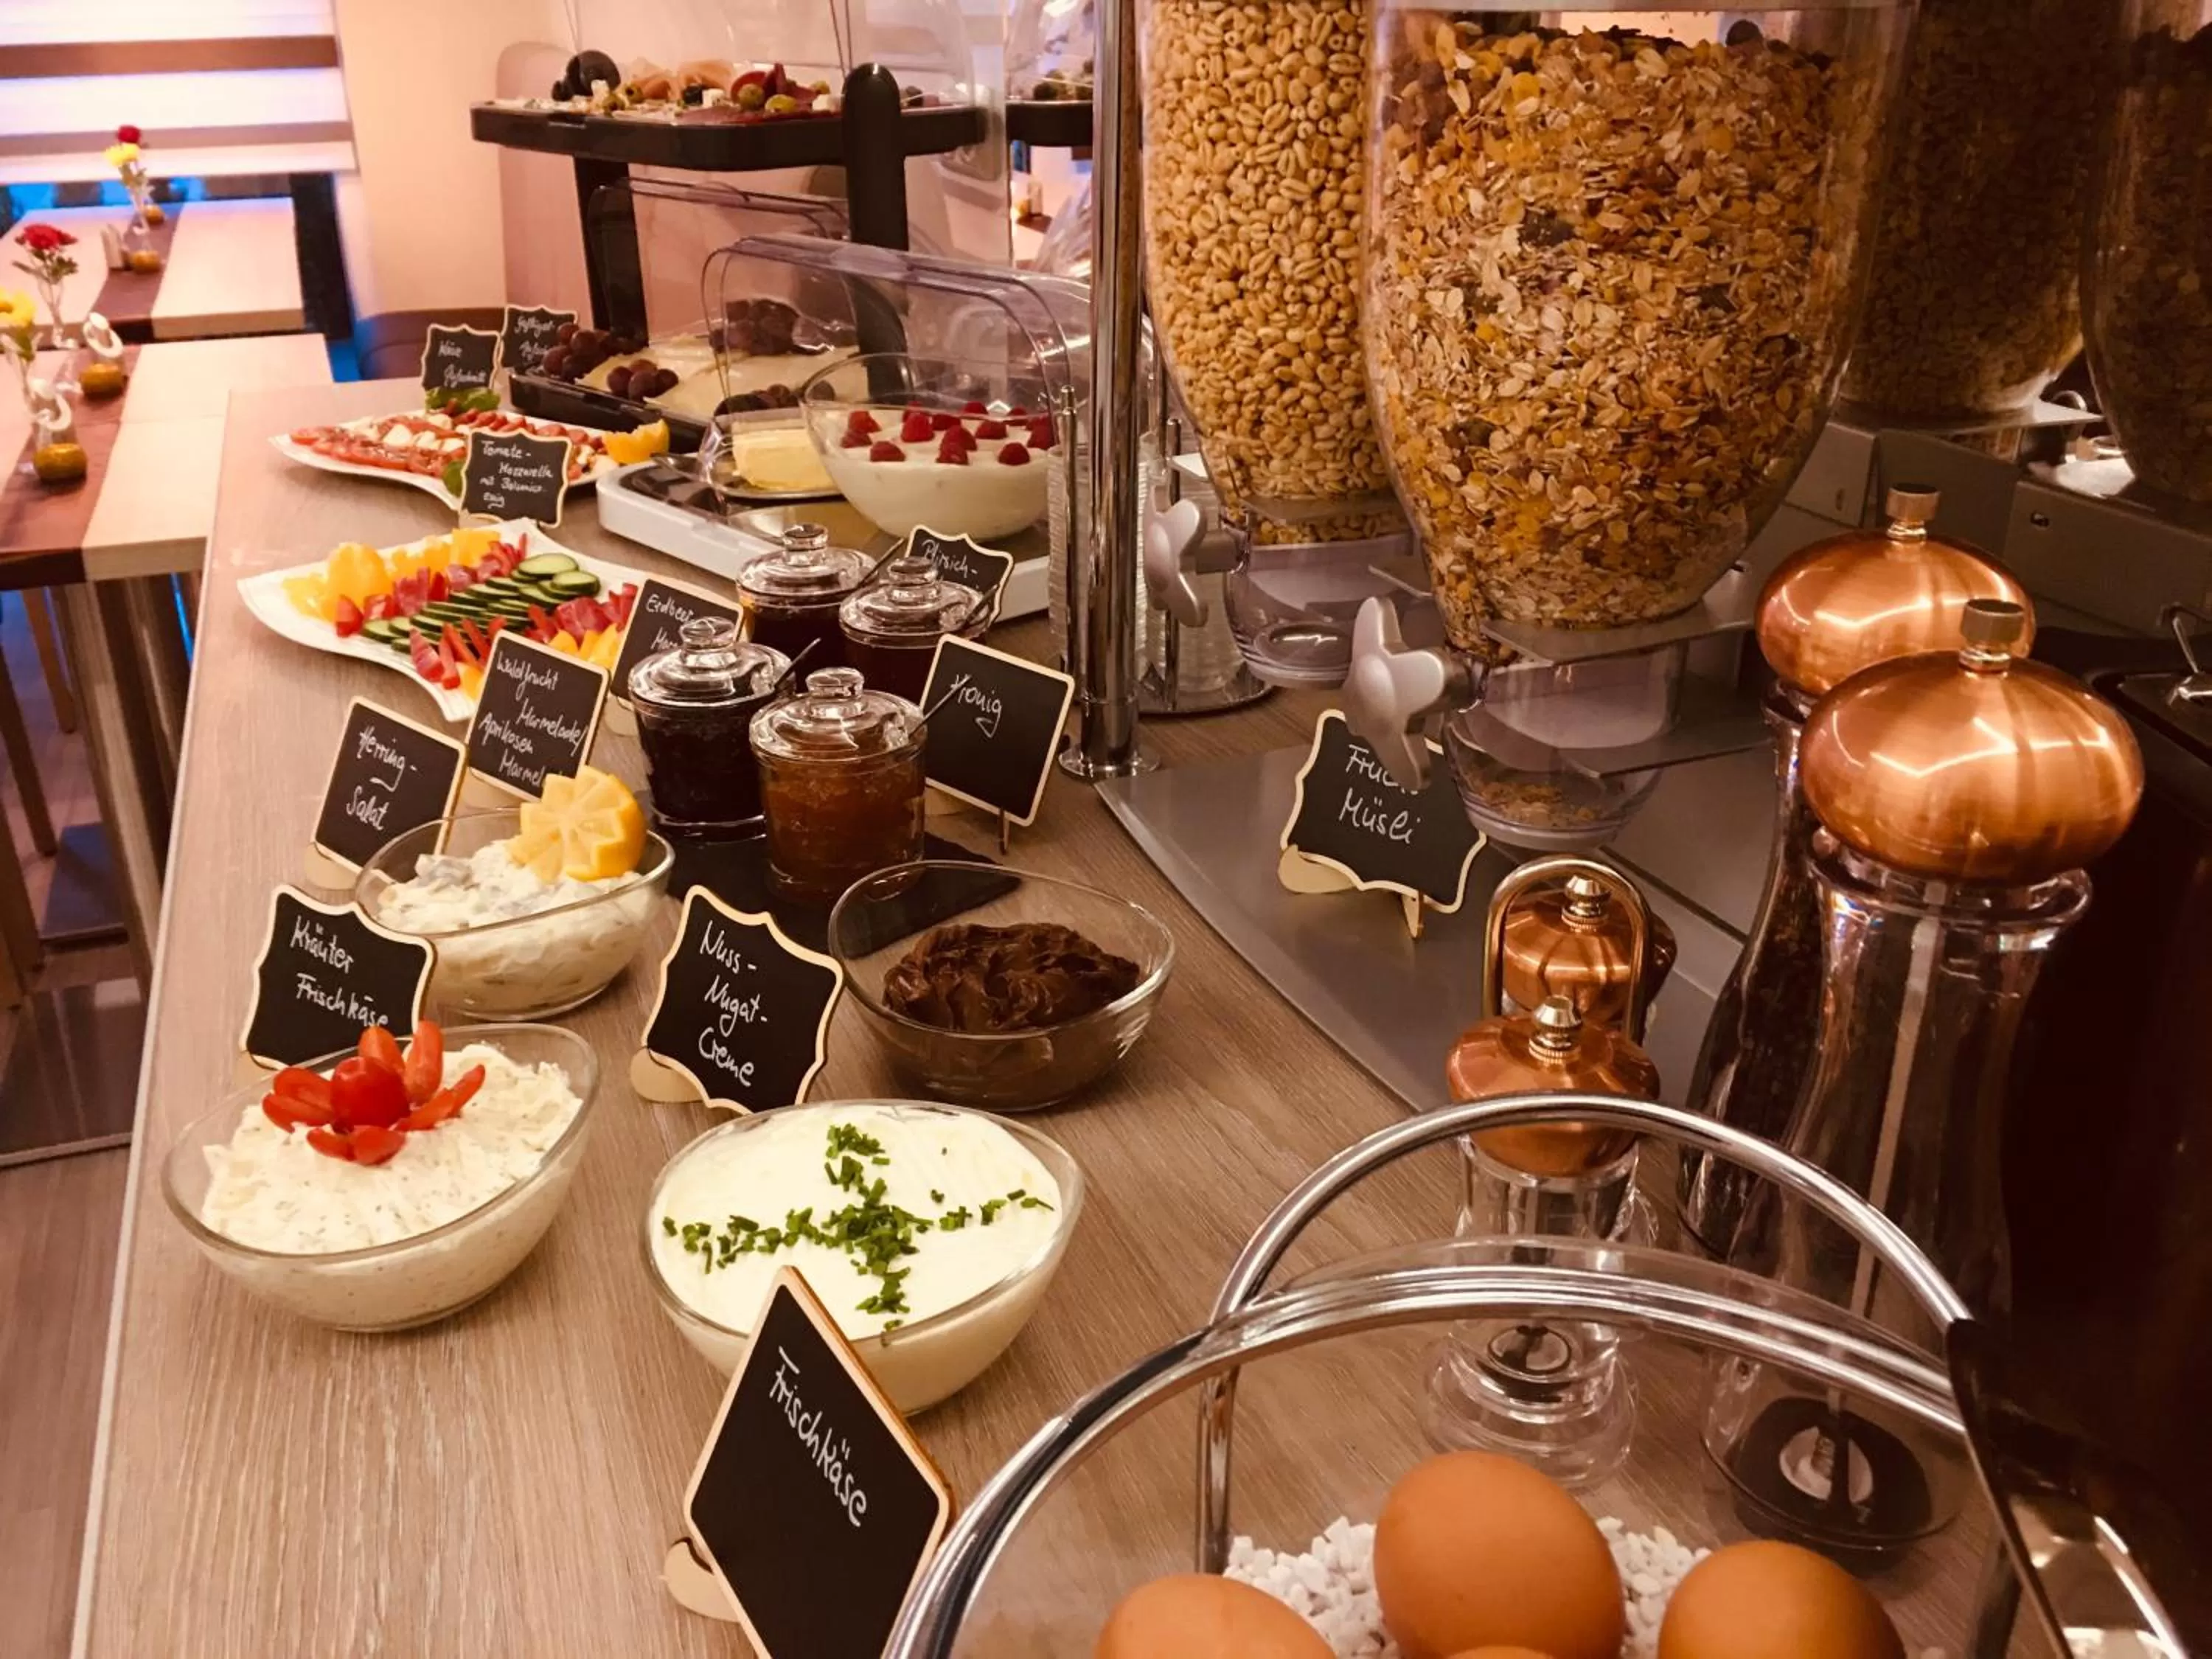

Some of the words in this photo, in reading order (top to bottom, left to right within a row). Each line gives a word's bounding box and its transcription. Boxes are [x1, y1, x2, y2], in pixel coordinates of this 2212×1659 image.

[478, 712, 534, 747] Aprikosen
[346, 785, 390, 831] Salat
[1338, 787, 1422, 845] Müsli
[289, 914, 355, 975] Kräuter
[699, 919, 758, 975] Nuss-
[296, 972, 389, 1027] Frischkäse
[703, 974, 768, 1037] Nugat-
[698, 1026, 755, 1088] Creme
[768, 1346, 868, 1528] Frischkäse
